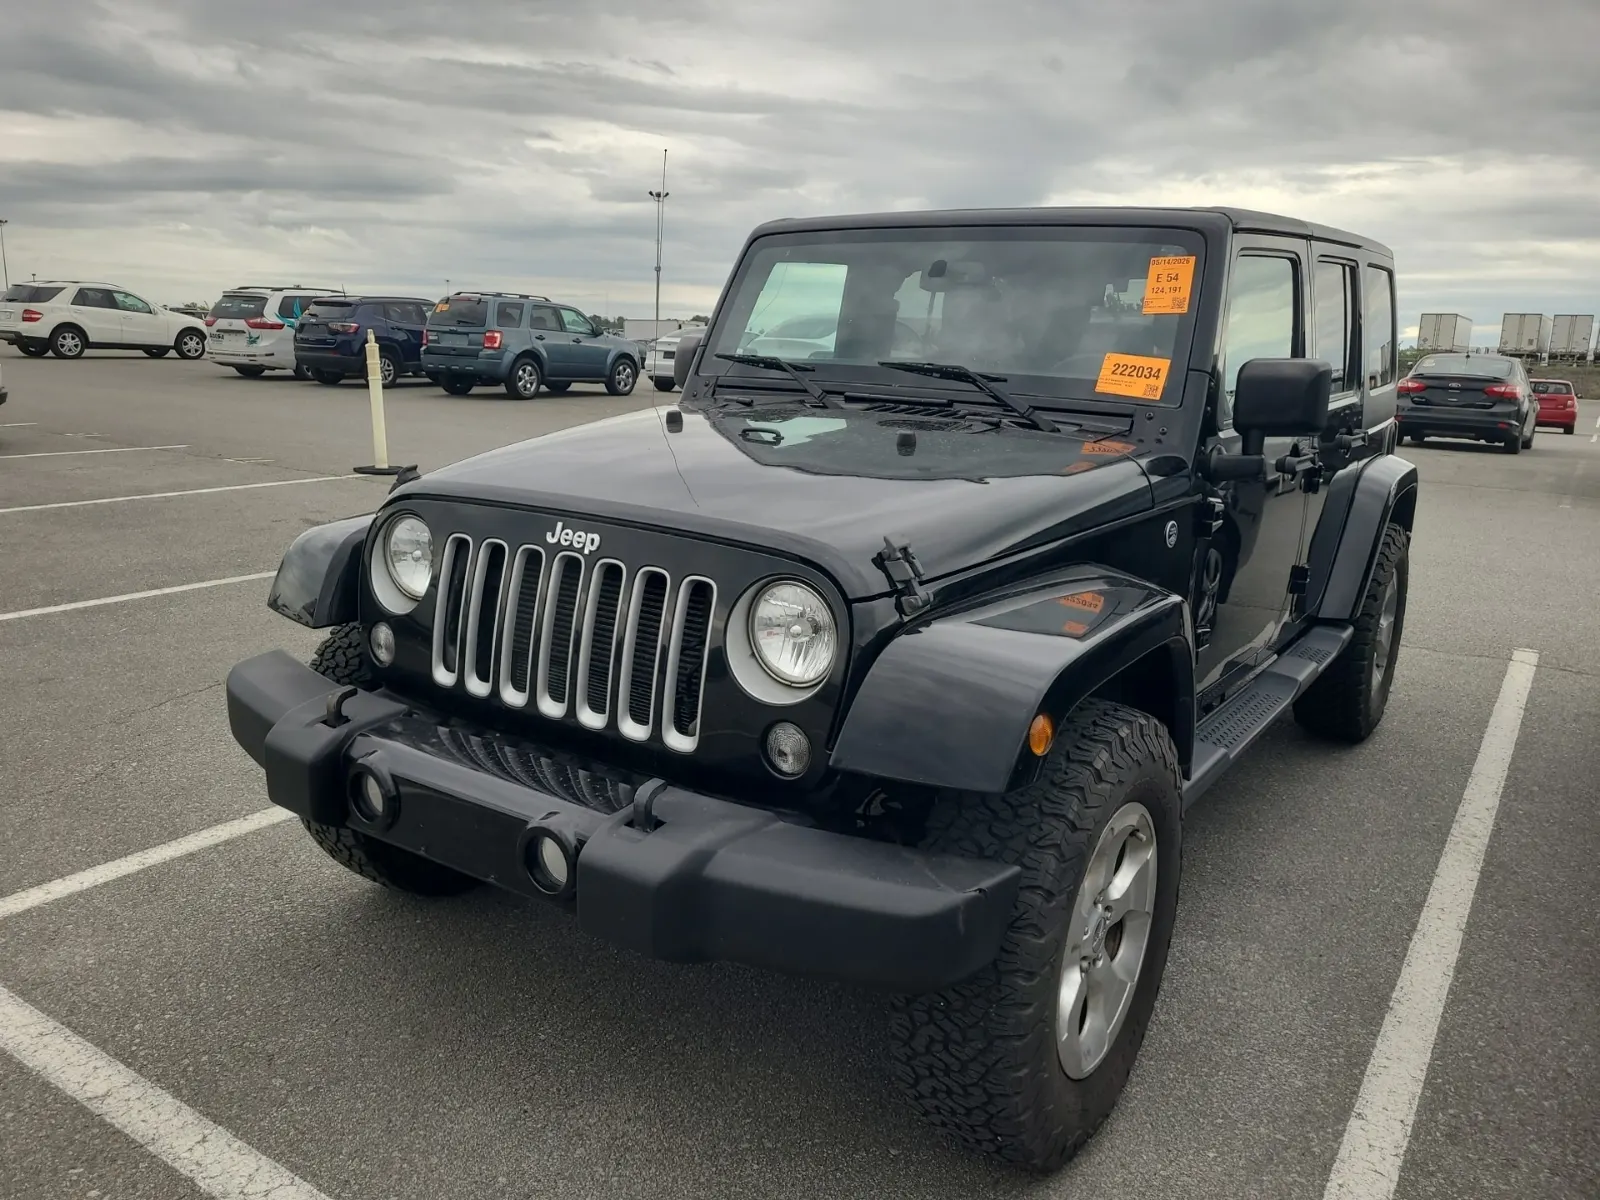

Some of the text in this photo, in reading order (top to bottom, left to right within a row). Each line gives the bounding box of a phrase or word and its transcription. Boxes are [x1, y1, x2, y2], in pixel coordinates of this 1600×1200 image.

[1156, 273, 1179, 283] E 54
[1151, 286, 1182, 294] 124,191
[1111, 363, 1161, 380] 222034
[546, 521, 601, 555] Jeep
